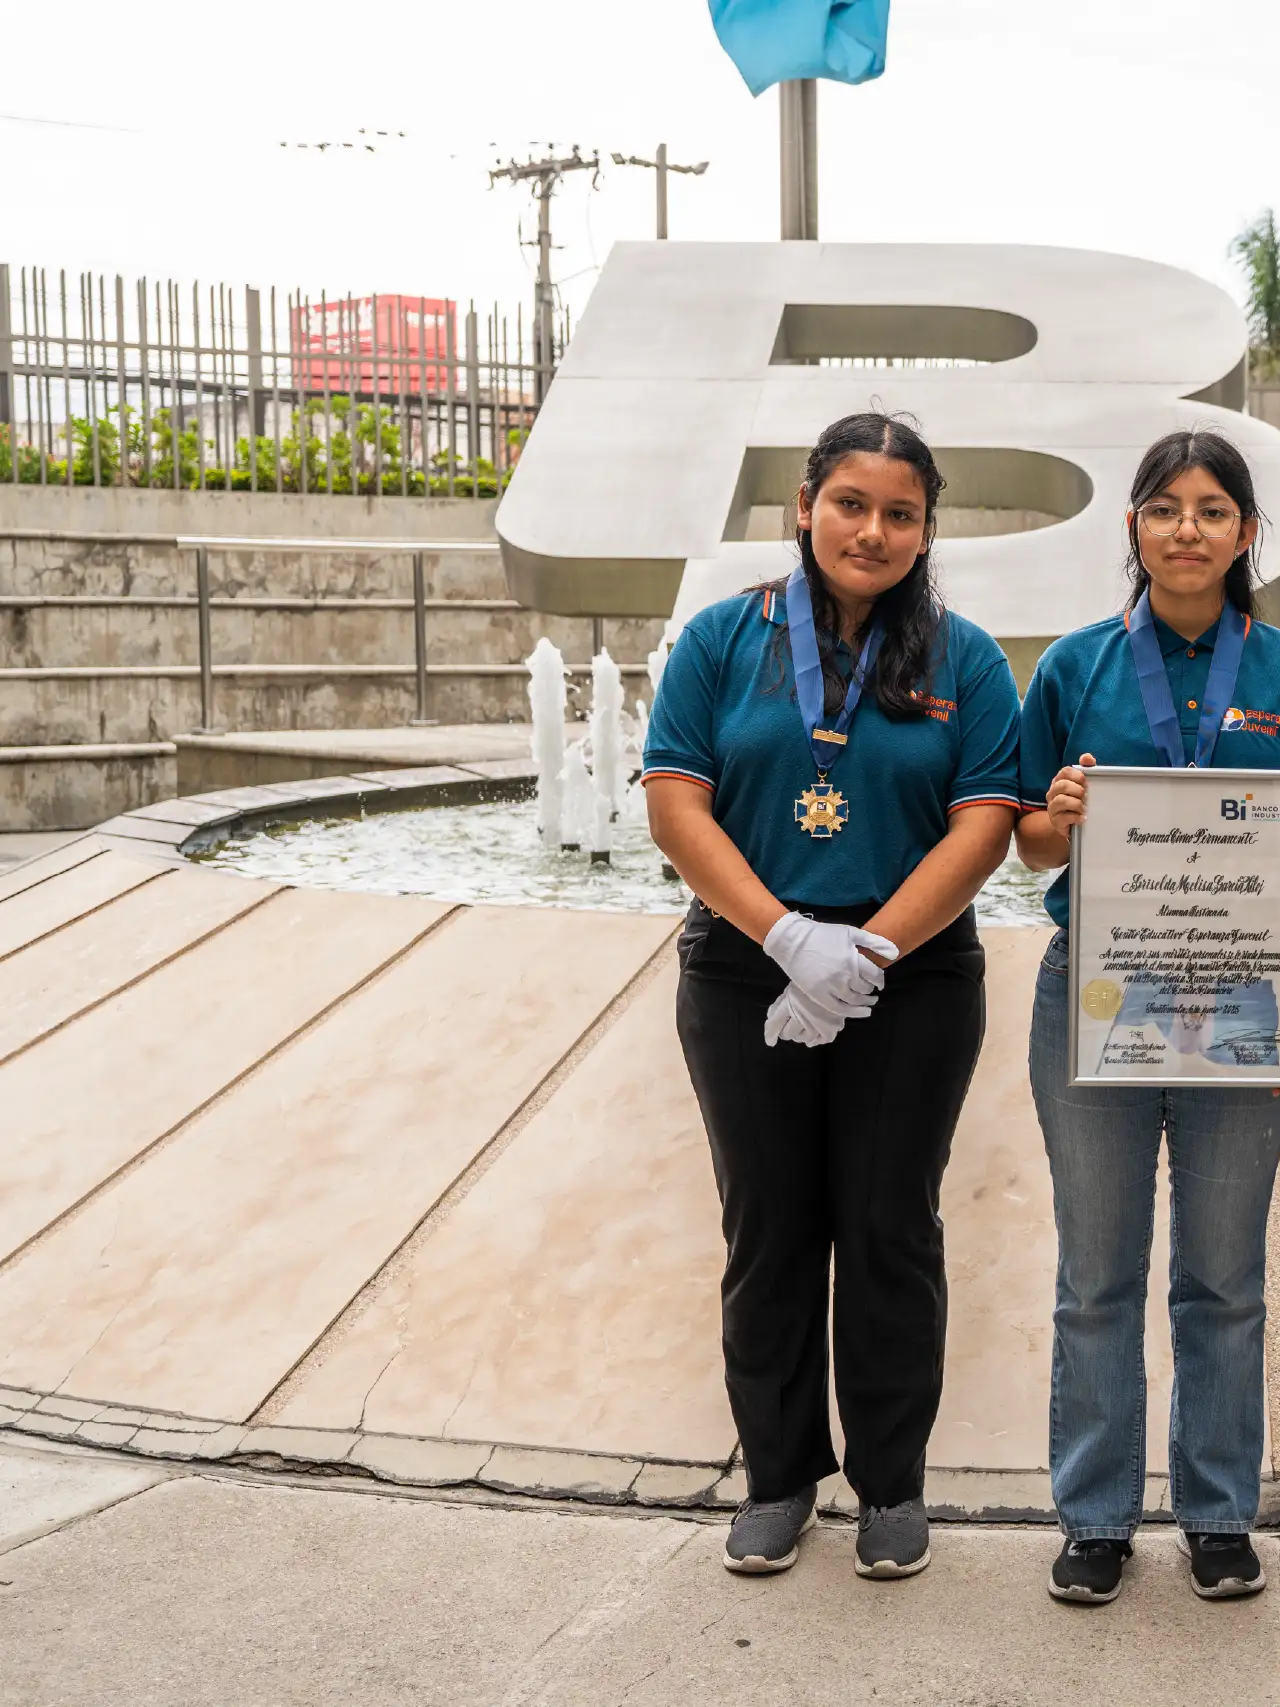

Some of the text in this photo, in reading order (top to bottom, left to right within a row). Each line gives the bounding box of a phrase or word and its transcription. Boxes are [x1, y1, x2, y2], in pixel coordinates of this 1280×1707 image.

[1241, 720, 1279, 737] Juvenil
[1221, 798, 1247, 820] Bi
[1193, 828, 1259, 846] Permanente
[1186, 851, 1201, 863] A
[1121, 873, 1176, 894] Griselda
[1172, 874, 1212, 894] Melisa
[1111, 926, 1274, 945] Centro Educativo Esperanza Juvenil
[1099, 947, 1112, 959] A
[1147, 950, 1160, 959] sus
